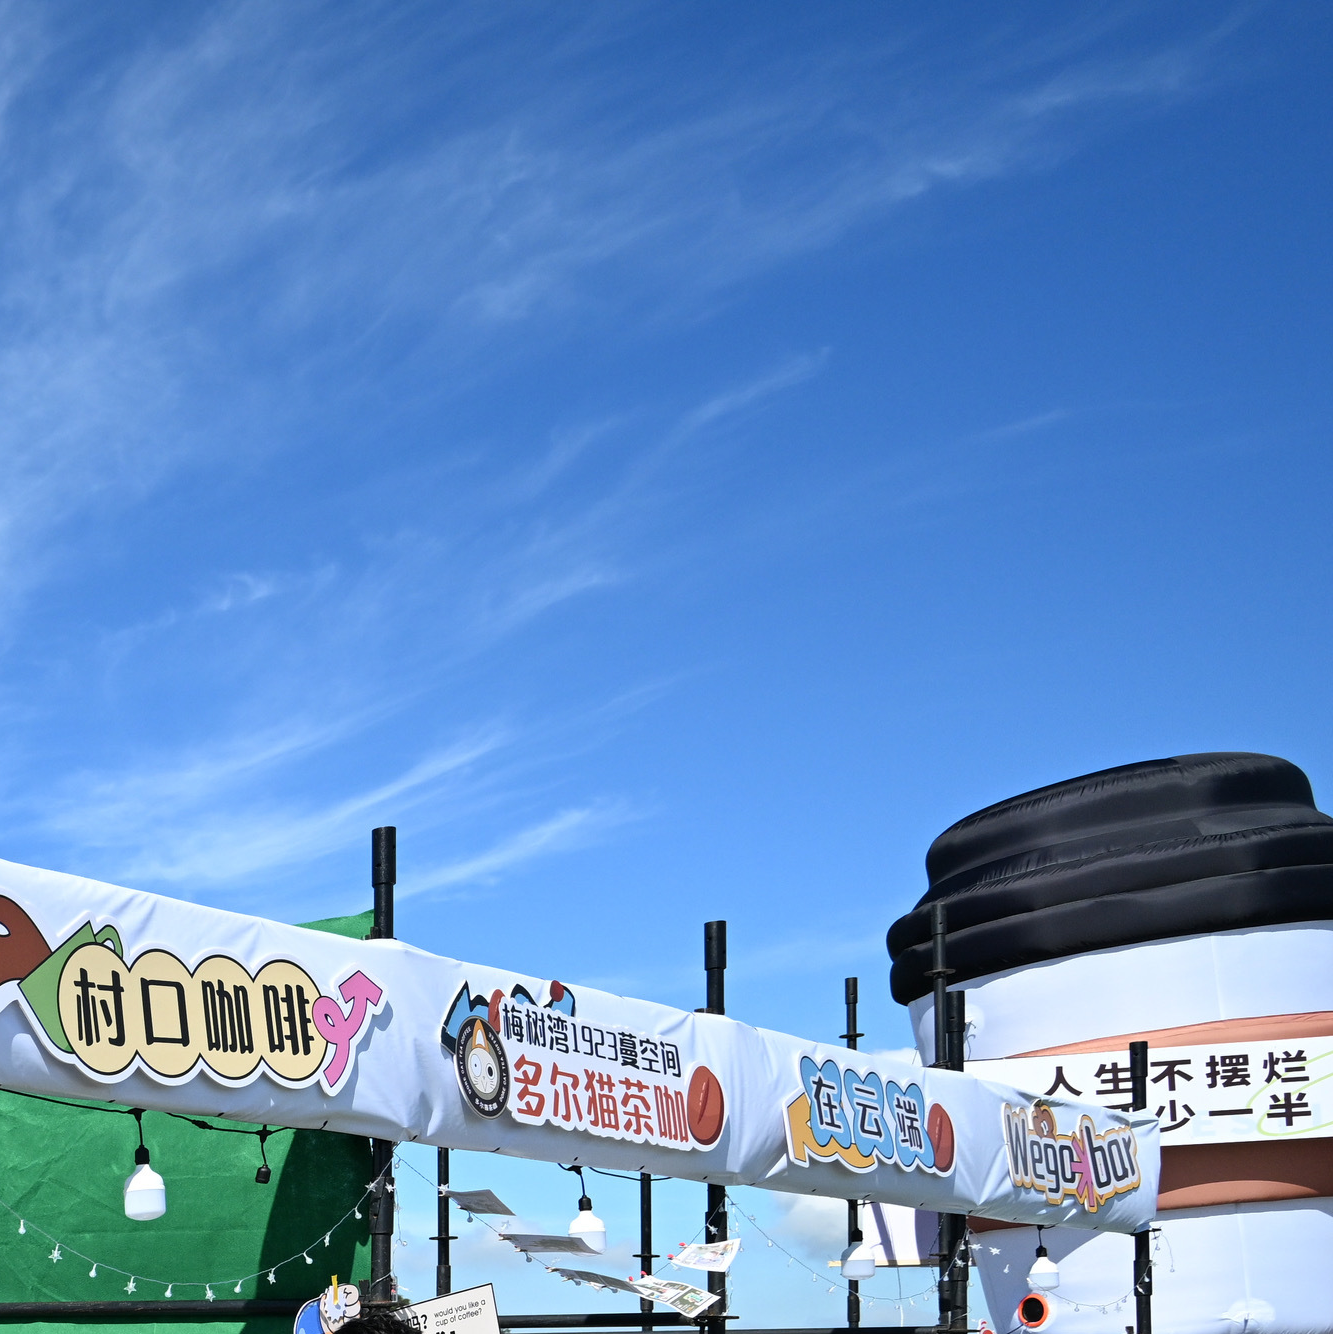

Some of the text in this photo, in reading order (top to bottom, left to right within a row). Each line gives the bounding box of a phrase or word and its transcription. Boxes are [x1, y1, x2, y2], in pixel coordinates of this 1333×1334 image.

[74, 968, 313, 1055] 村口咖啡
[502, 1003, 681, 1077] 梅树湾1923蔓空间
[514, 1054, 689, 1142] 多尔猫茶咖
[1044, 1050, 1310, 1096] 人生不摆烂
[812, 1073, 921, 1149] 在云端
[1103, 1092, 1312, 1133] 少一半
[1085, 1126, 1136, 1189] bar
[434, 1306, 453, 1318] would
[455, 1304, 467, 1315] you
[468, 1301, 479, 1311] like
[435, 1308, 483, 1328] cup of coffee?
